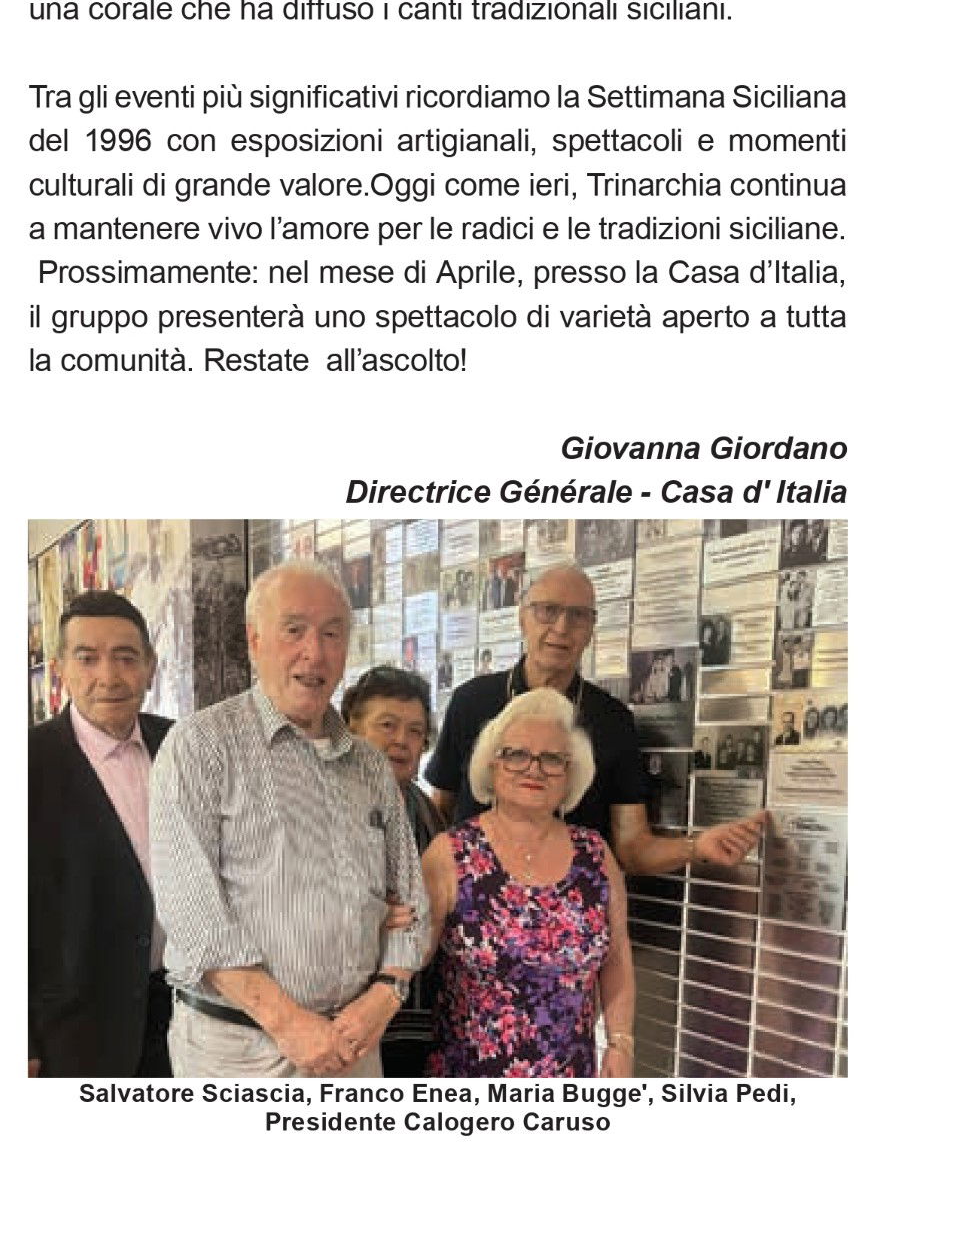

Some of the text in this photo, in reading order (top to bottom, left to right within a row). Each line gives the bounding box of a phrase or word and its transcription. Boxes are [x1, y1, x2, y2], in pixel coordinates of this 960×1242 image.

[28, 128, 846, 158] del 1996 con esposizioni artigianali, spettacoli e momenti
[39, 259, 845, 290] Prossimamente: nel mese di Aprile, presso la Casa d’Italia,
[561, 435, 848, 460] Giovanna Giordano
[345, 478, 848, 504] Directrice Générale Casa d' Italia
[79, 1083, 796, 1108] Salvatore Sciascia, Franco Enea, Maria Bugge', Silvia Pedi,
[265, 1111, 611, 1137] Presidente Calogero Caruso
